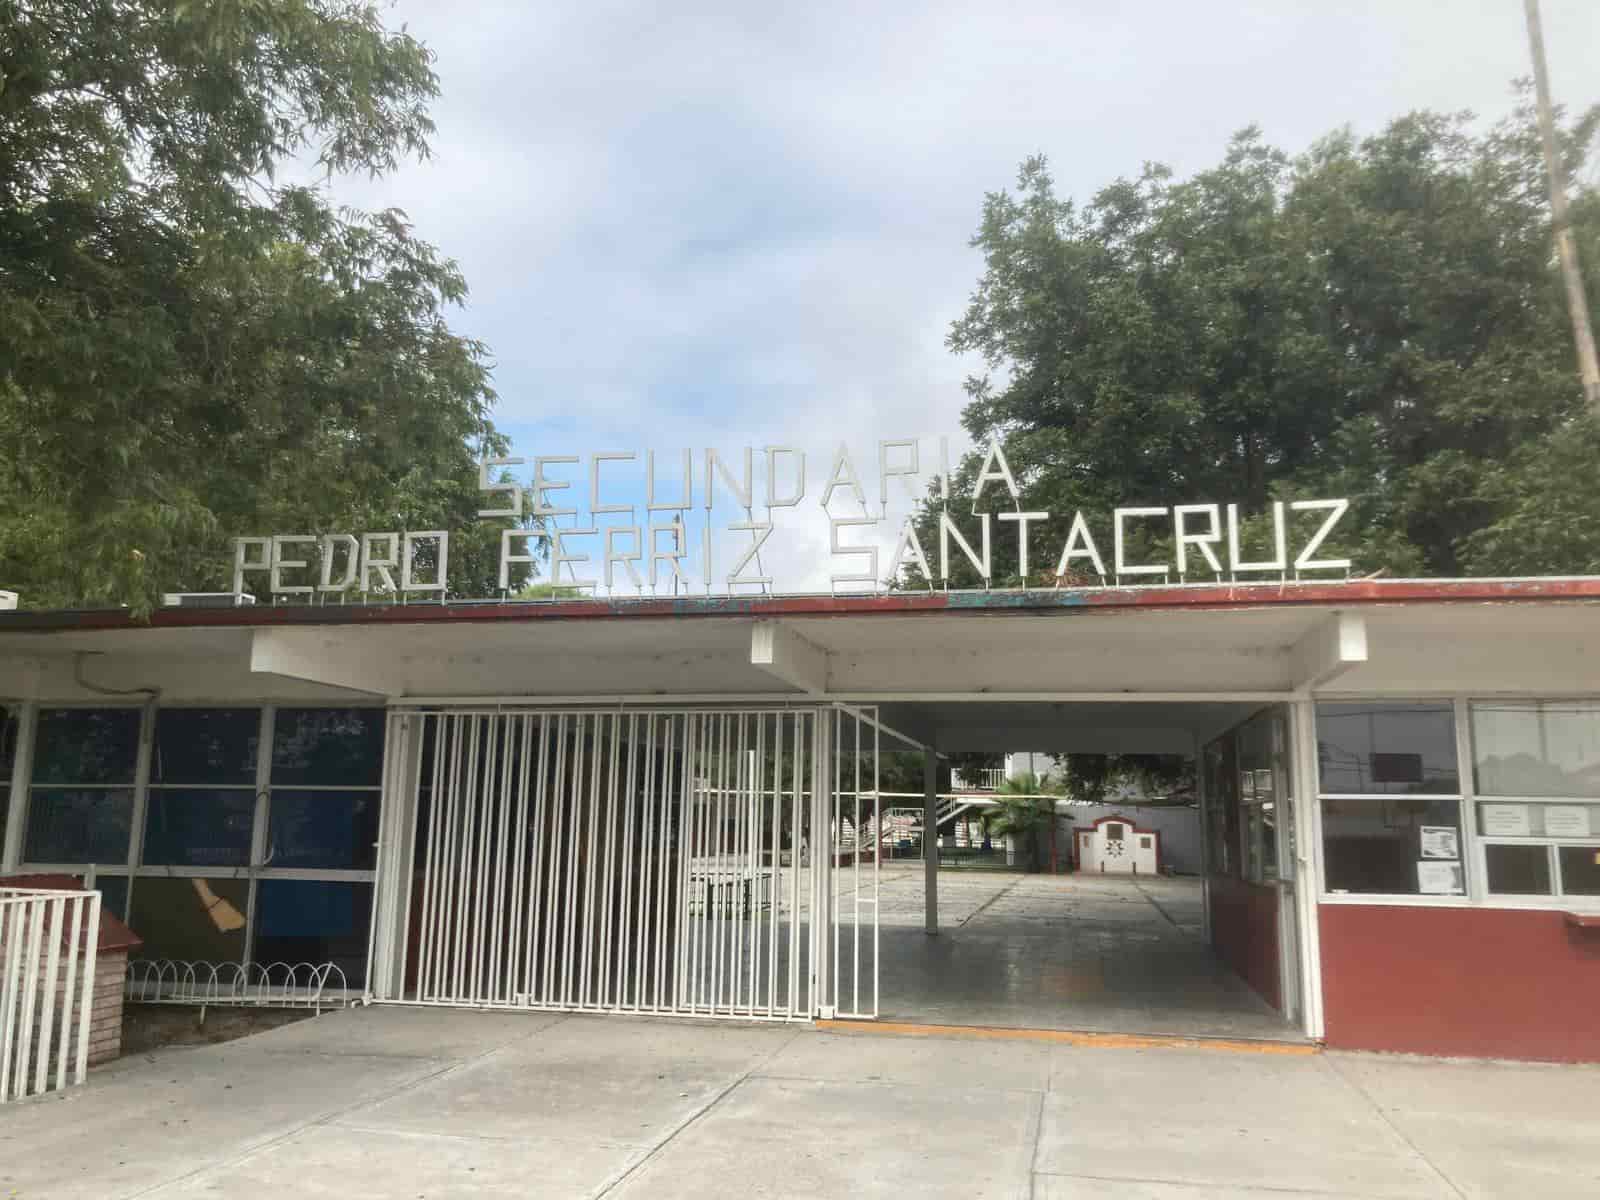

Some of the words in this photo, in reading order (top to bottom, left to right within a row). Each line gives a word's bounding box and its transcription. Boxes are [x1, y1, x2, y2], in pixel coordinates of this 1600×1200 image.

[478, 438, 1019, 517] SECUNDARIA
[234, 530, 448, 593] PEDRO
[499, 522, 773, 589] FERRIZ
